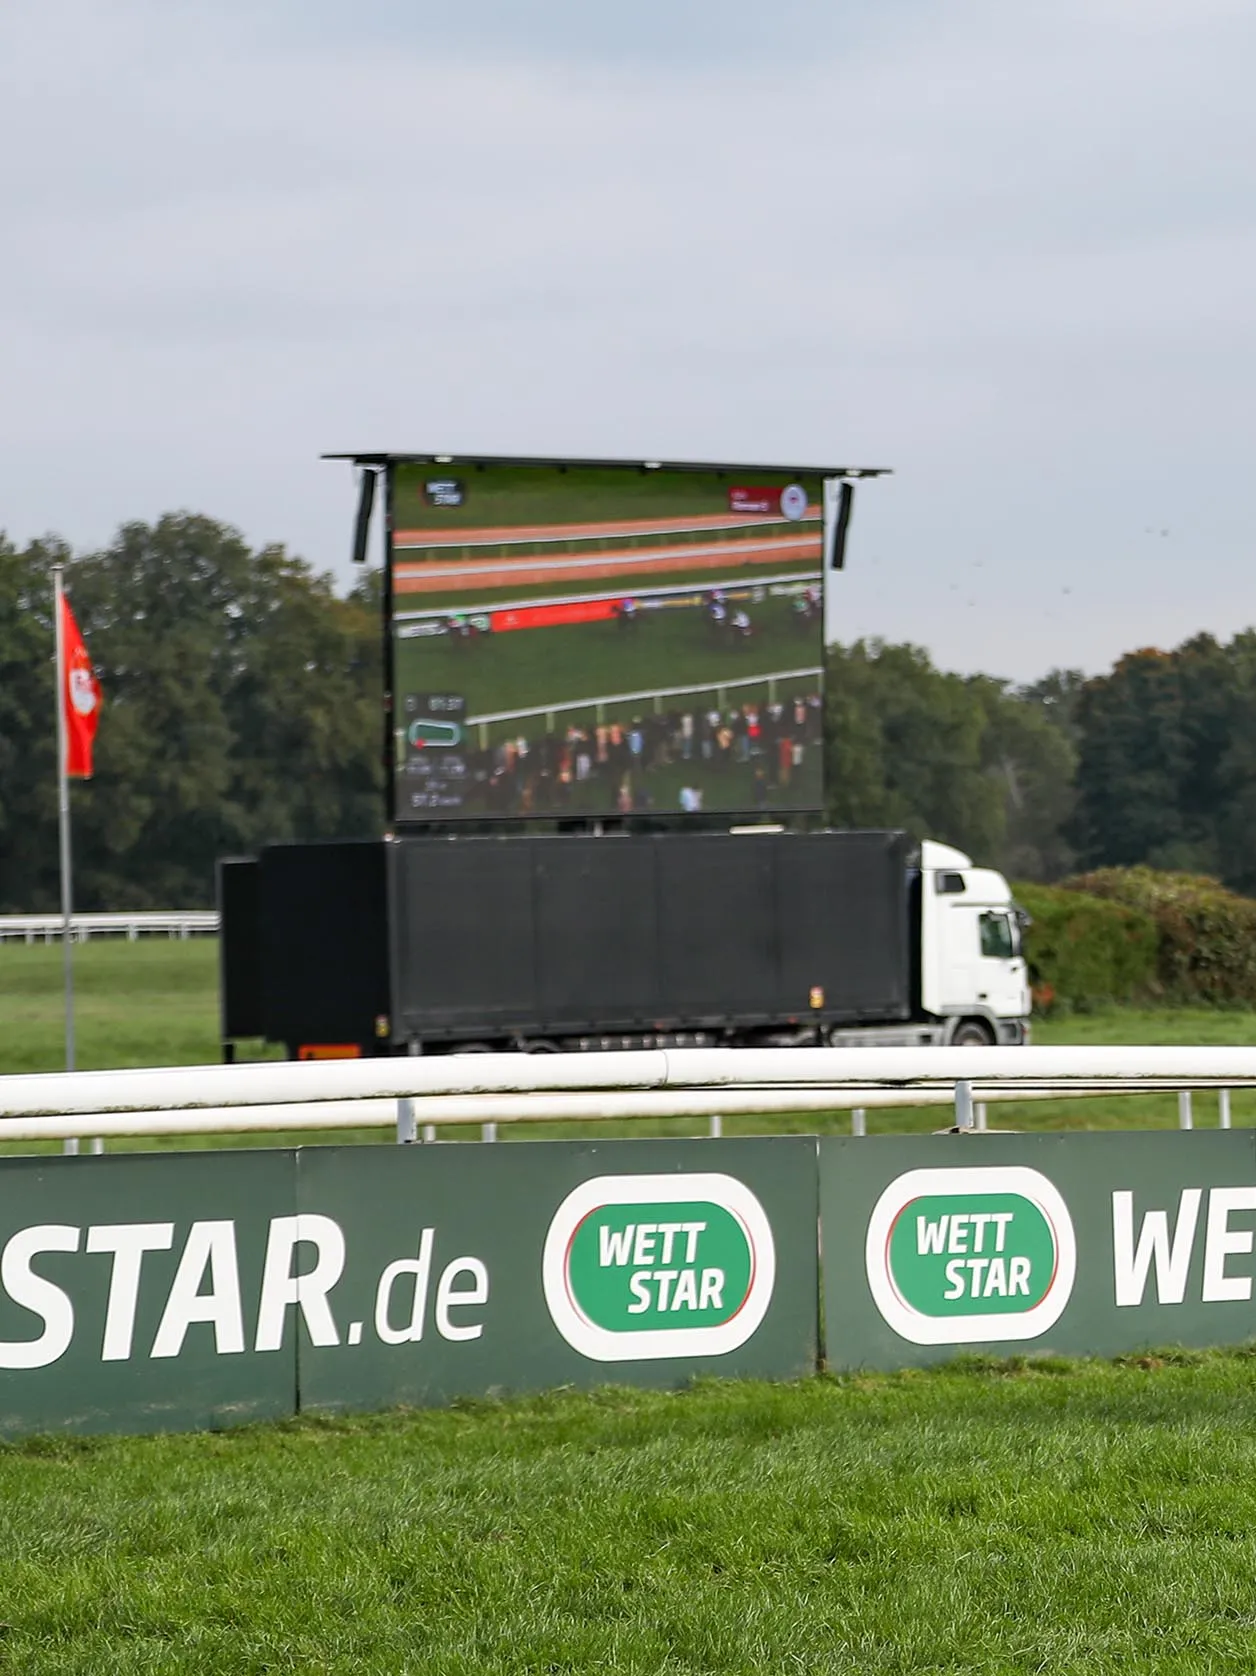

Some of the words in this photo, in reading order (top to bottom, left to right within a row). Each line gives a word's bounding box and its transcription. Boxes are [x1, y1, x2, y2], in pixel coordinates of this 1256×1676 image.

[598, 1221, 707, 1268] WETT
[916, 1212, 1014, 1256] WETT
[0, 1213, 489, 1370] STAR.de
[627, 1267, 726, 1315] STAR
[943, 1256, 1032, 1301] STAR
